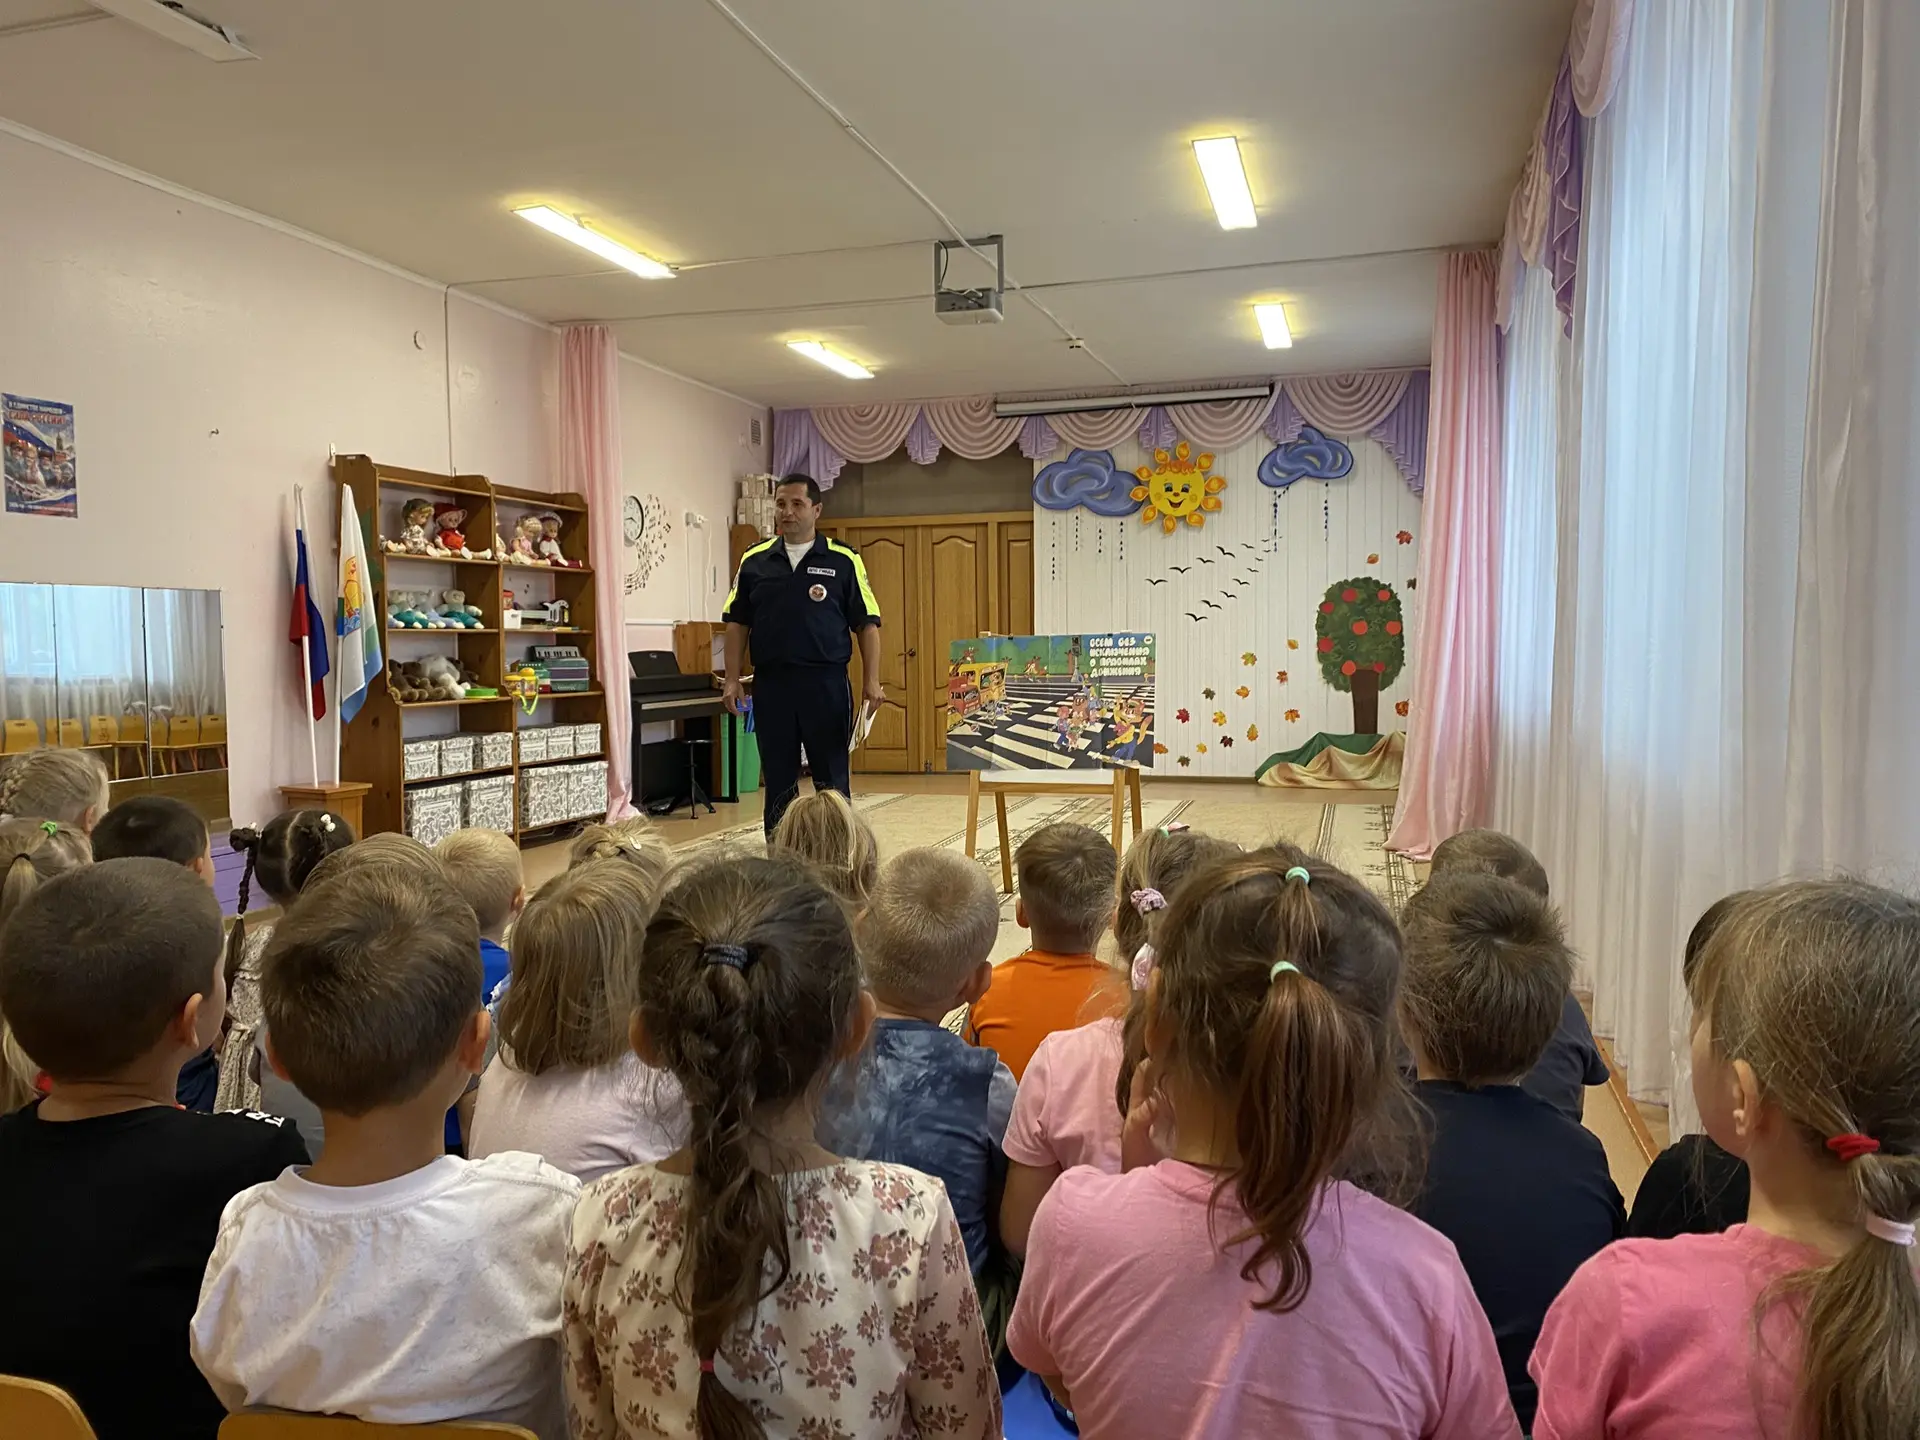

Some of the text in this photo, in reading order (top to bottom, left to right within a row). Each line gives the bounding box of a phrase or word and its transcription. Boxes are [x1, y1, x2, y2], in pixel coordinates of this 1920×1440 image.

[1090, 637, 1136, 647] ВСЕМ БЕЗ
[1090, 647, 1150, 657] ИСКЛЮЧЕНИЯ
[1090, 656, 1147, 667] О ПРАВИЛАХ
[1090, 667, 1141, 678] ДВИЖЕНИЯ
